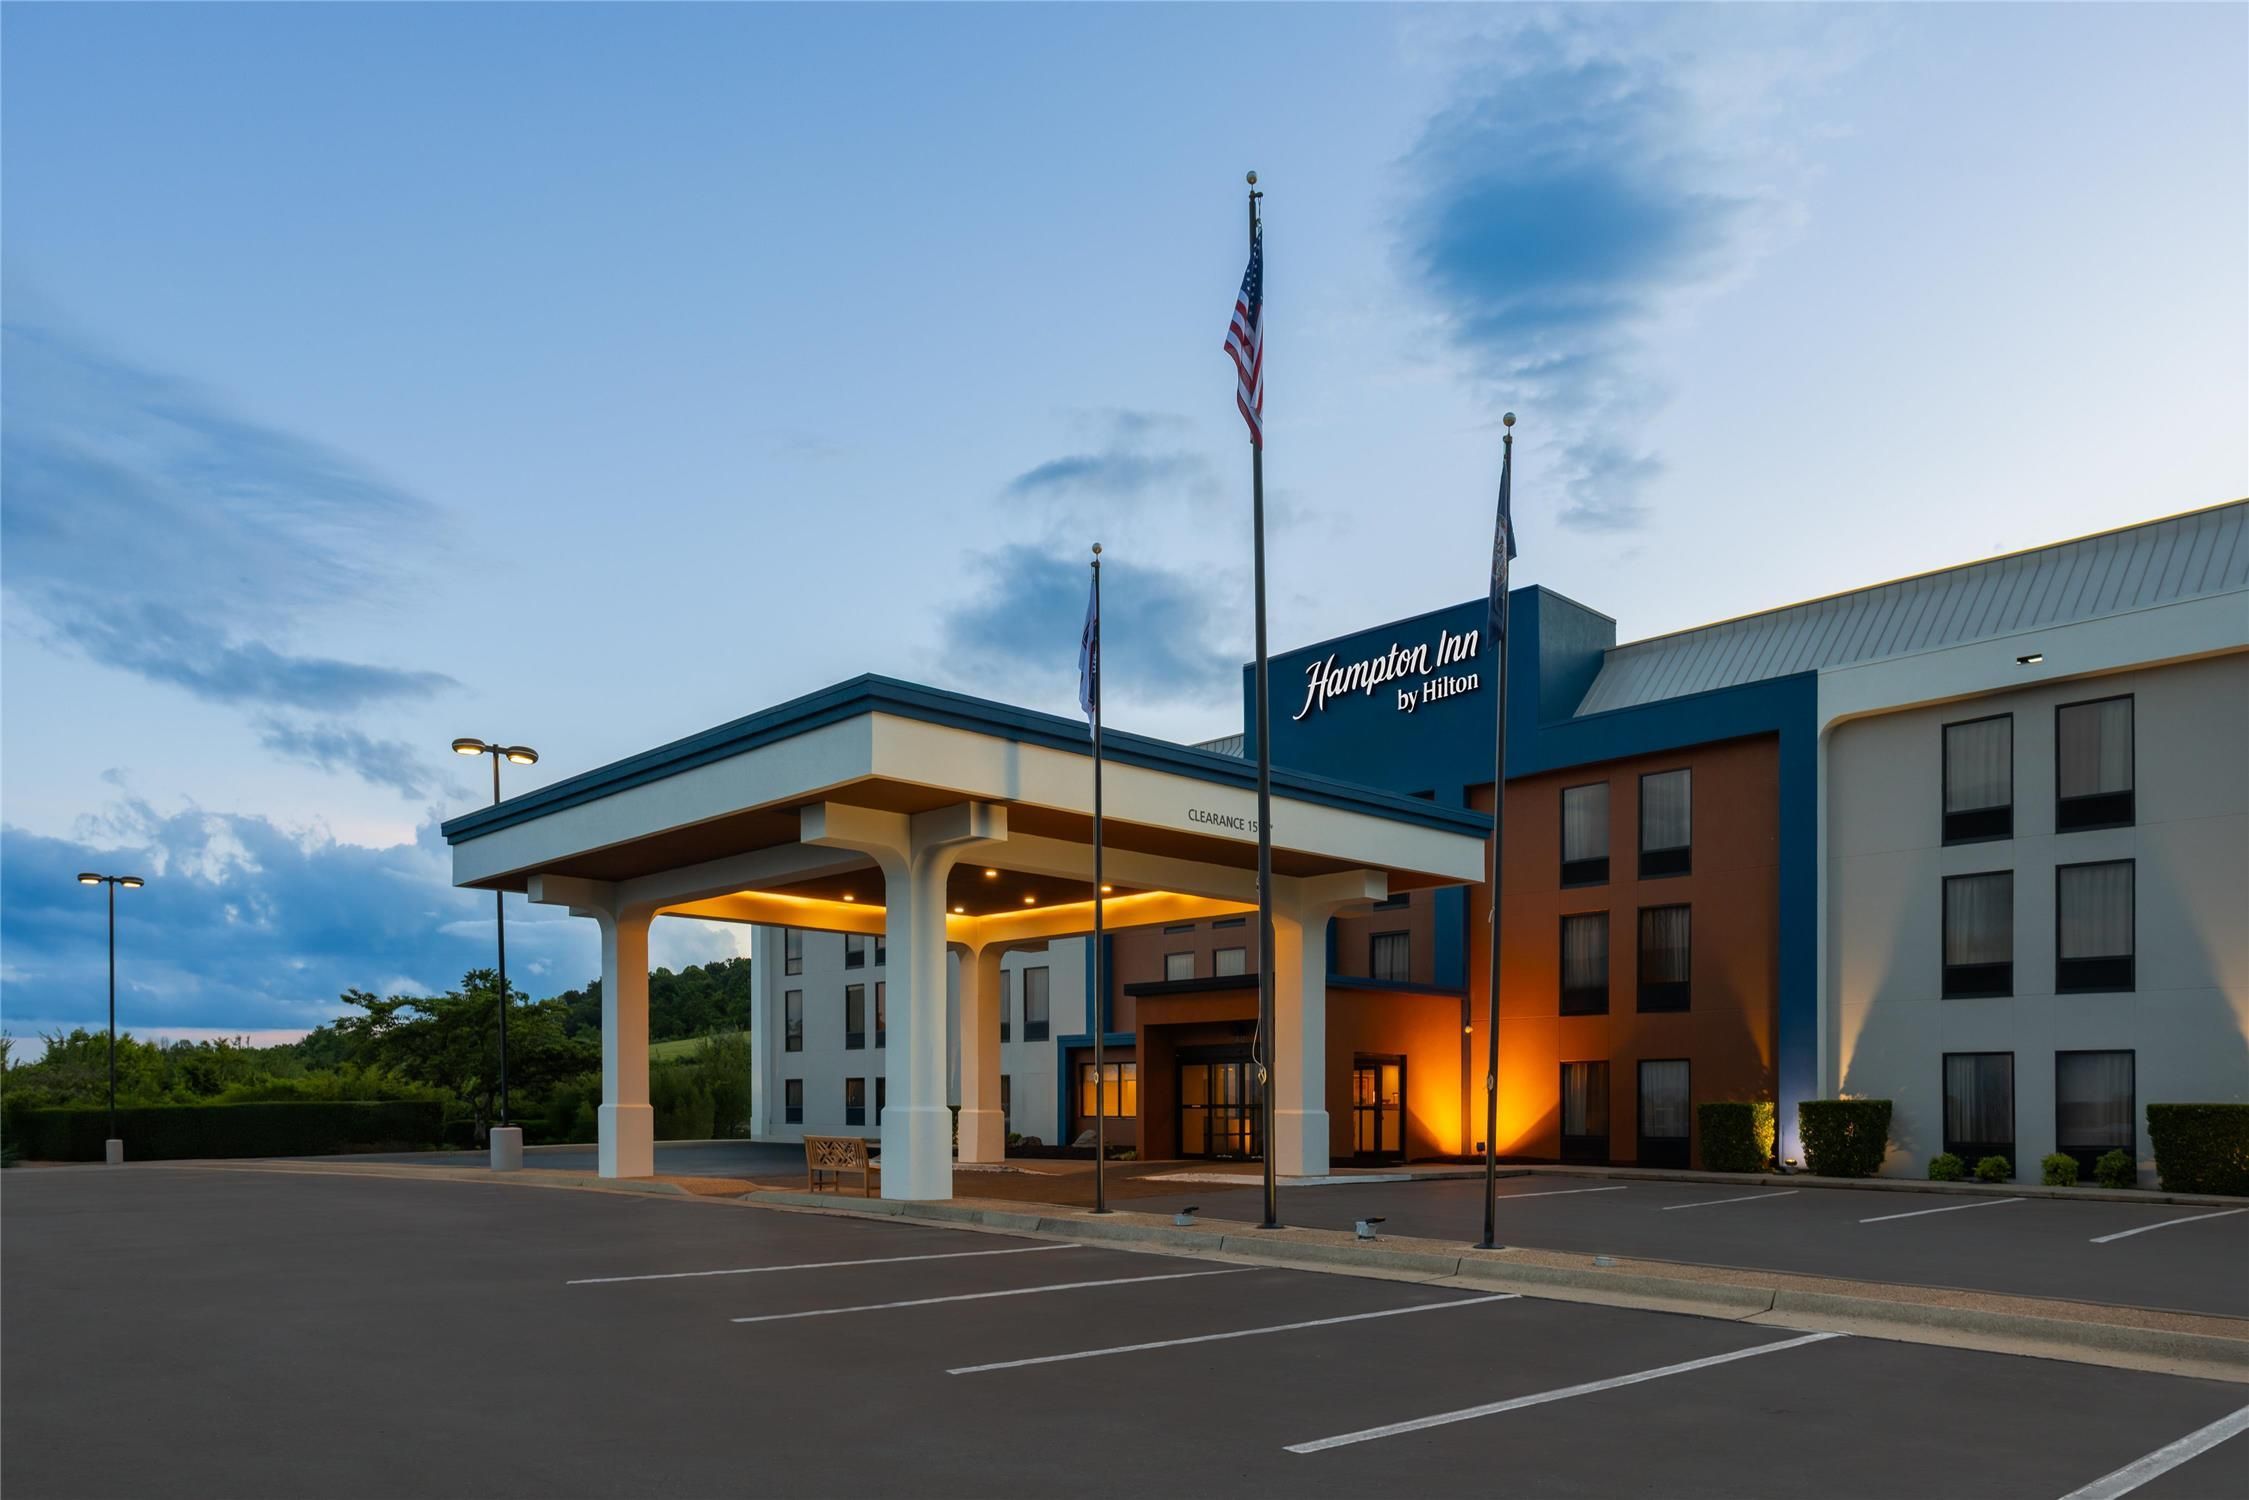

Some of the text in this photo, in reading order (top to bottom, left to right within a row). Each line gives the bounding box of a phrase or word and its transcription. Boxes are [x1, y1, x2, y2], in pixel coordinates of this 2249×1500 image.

[1293, 629, 1479, 720] Hampton Inn
[1397, 673, 1479, 713] by Hilton
[1188, 808, 1245, 830] CLEARANCE
